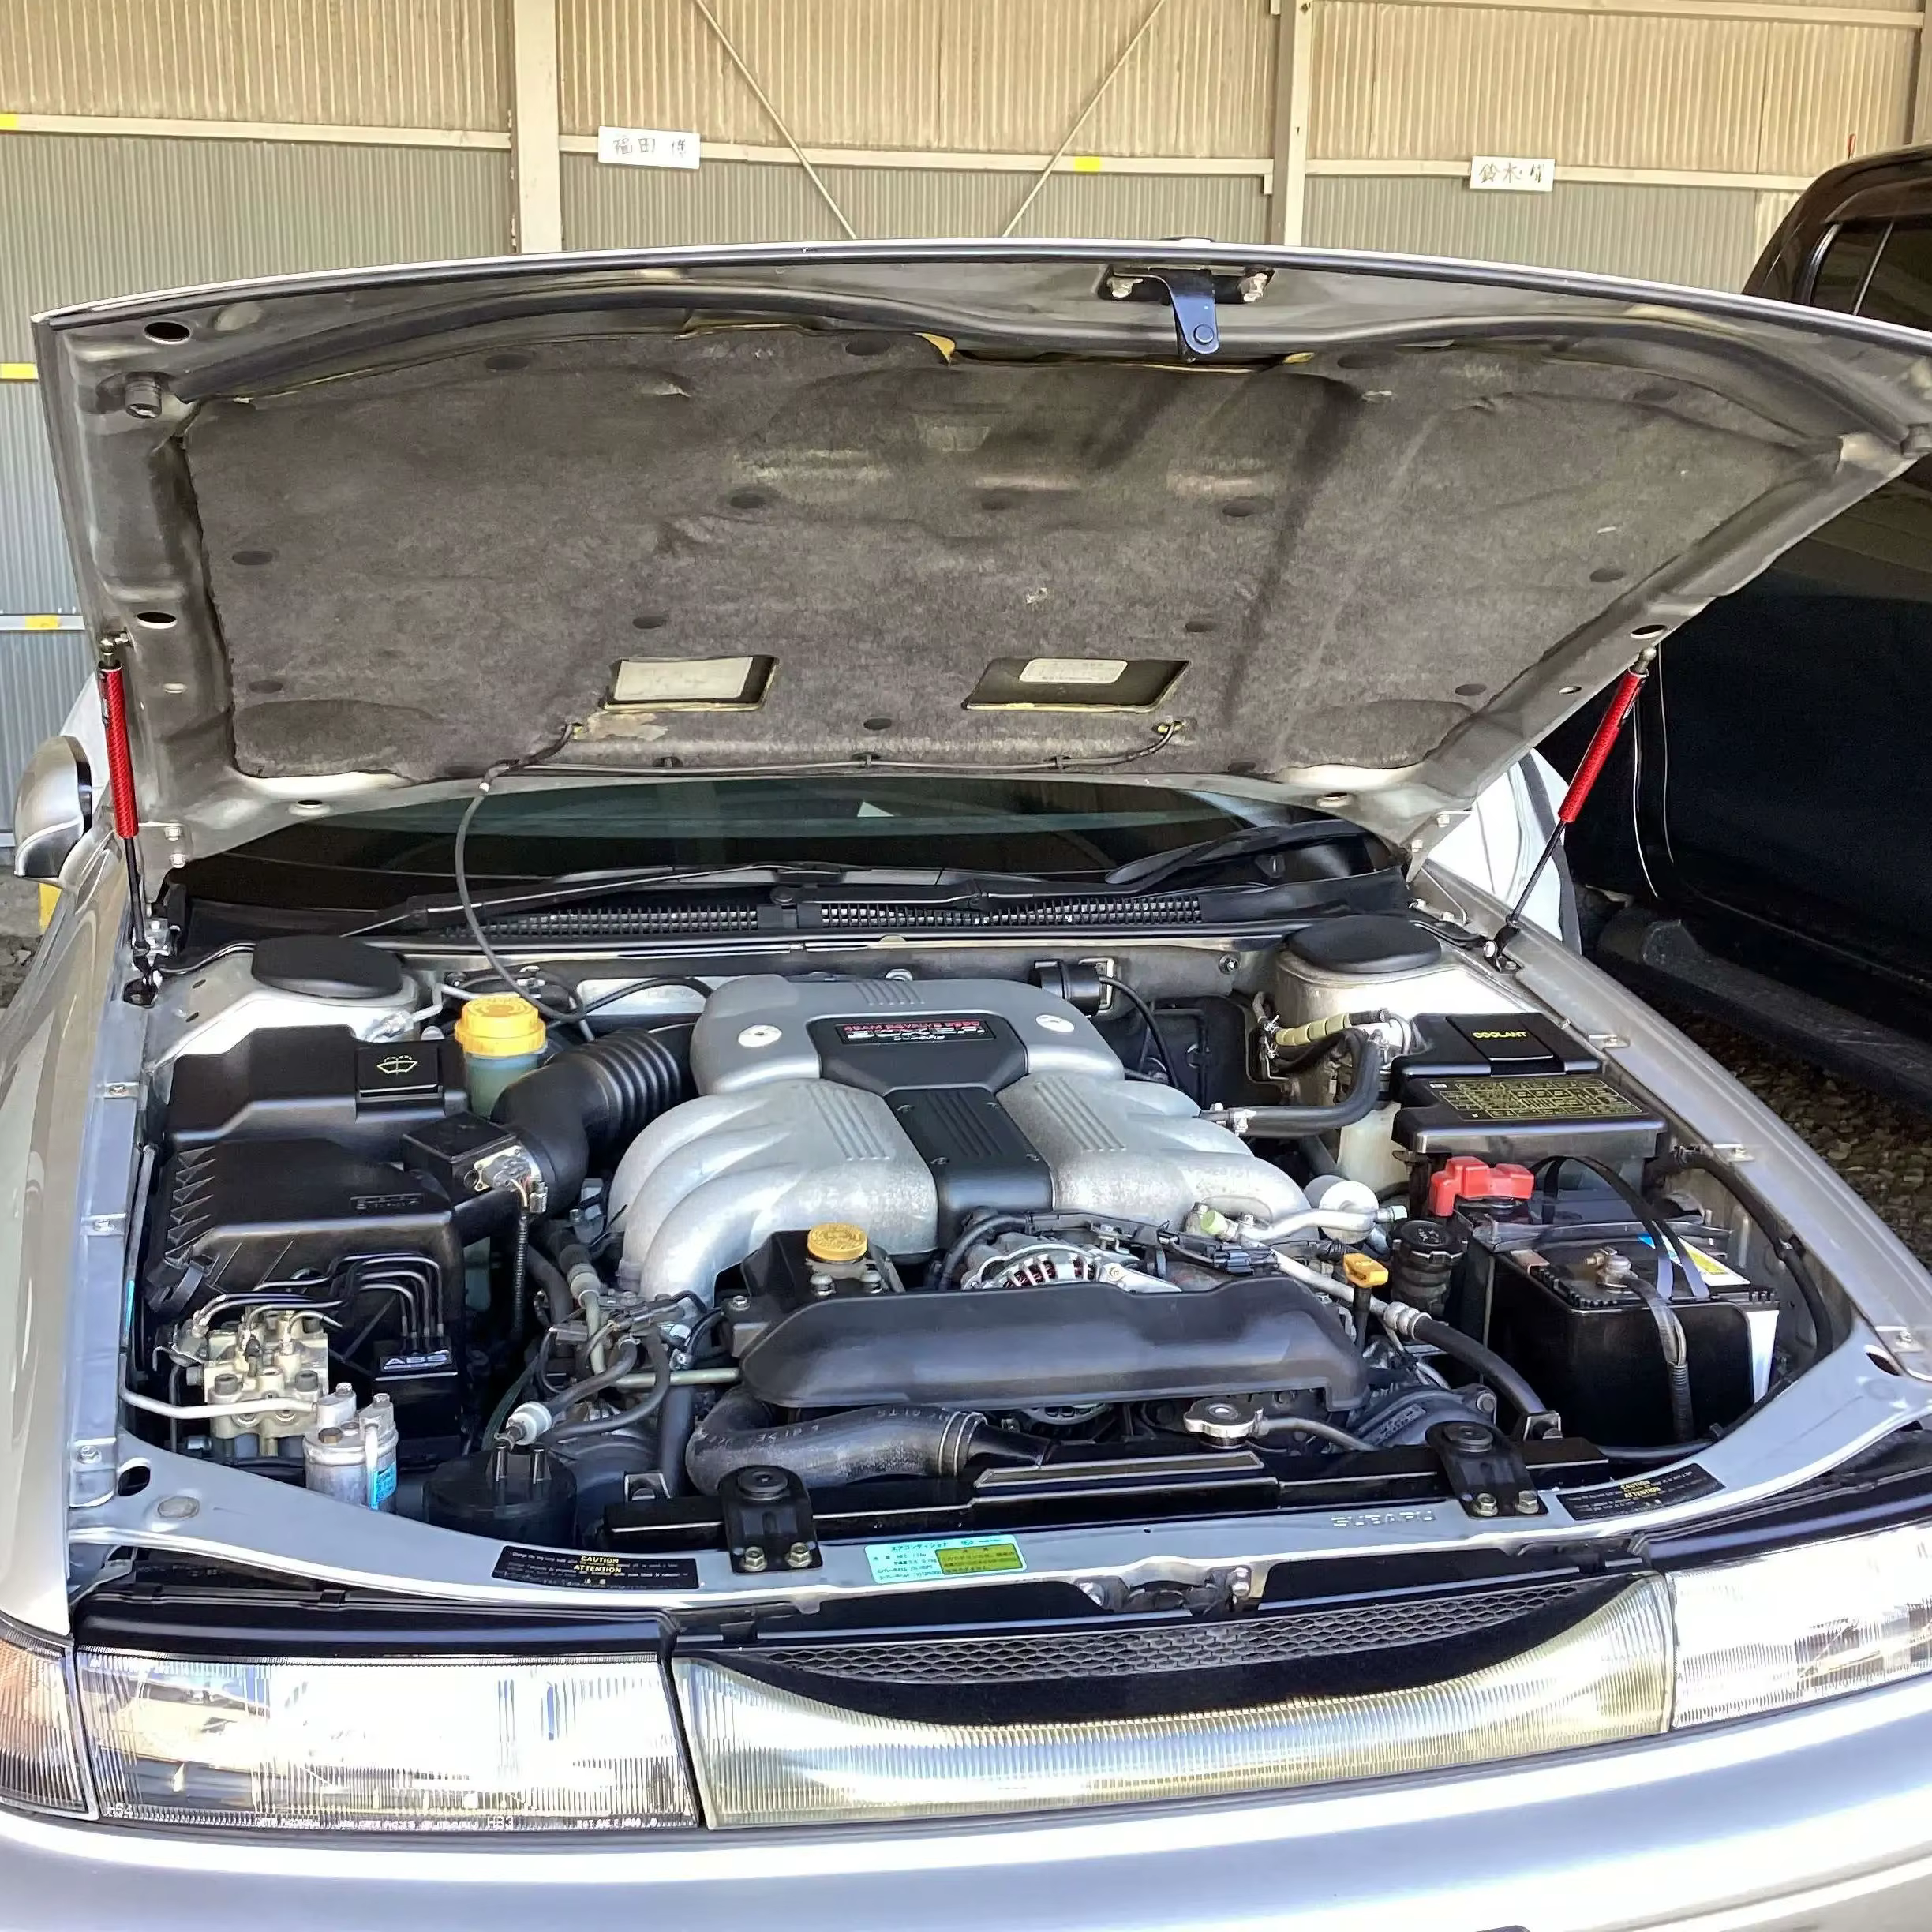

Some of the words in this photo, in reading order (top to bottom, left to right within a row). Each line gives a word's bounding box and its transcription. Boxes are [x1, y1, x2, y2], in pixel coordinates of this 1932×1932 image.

[1473, 1031, 1527, 1039] COOLANT
[384, 1354, 447, 1366] ABS
[1331, 1510, 1437, 1527] SUBARU
[580, 1556, 619, 1564] CAUTION
[574, 1563, 622, 1574] ATTENTION
